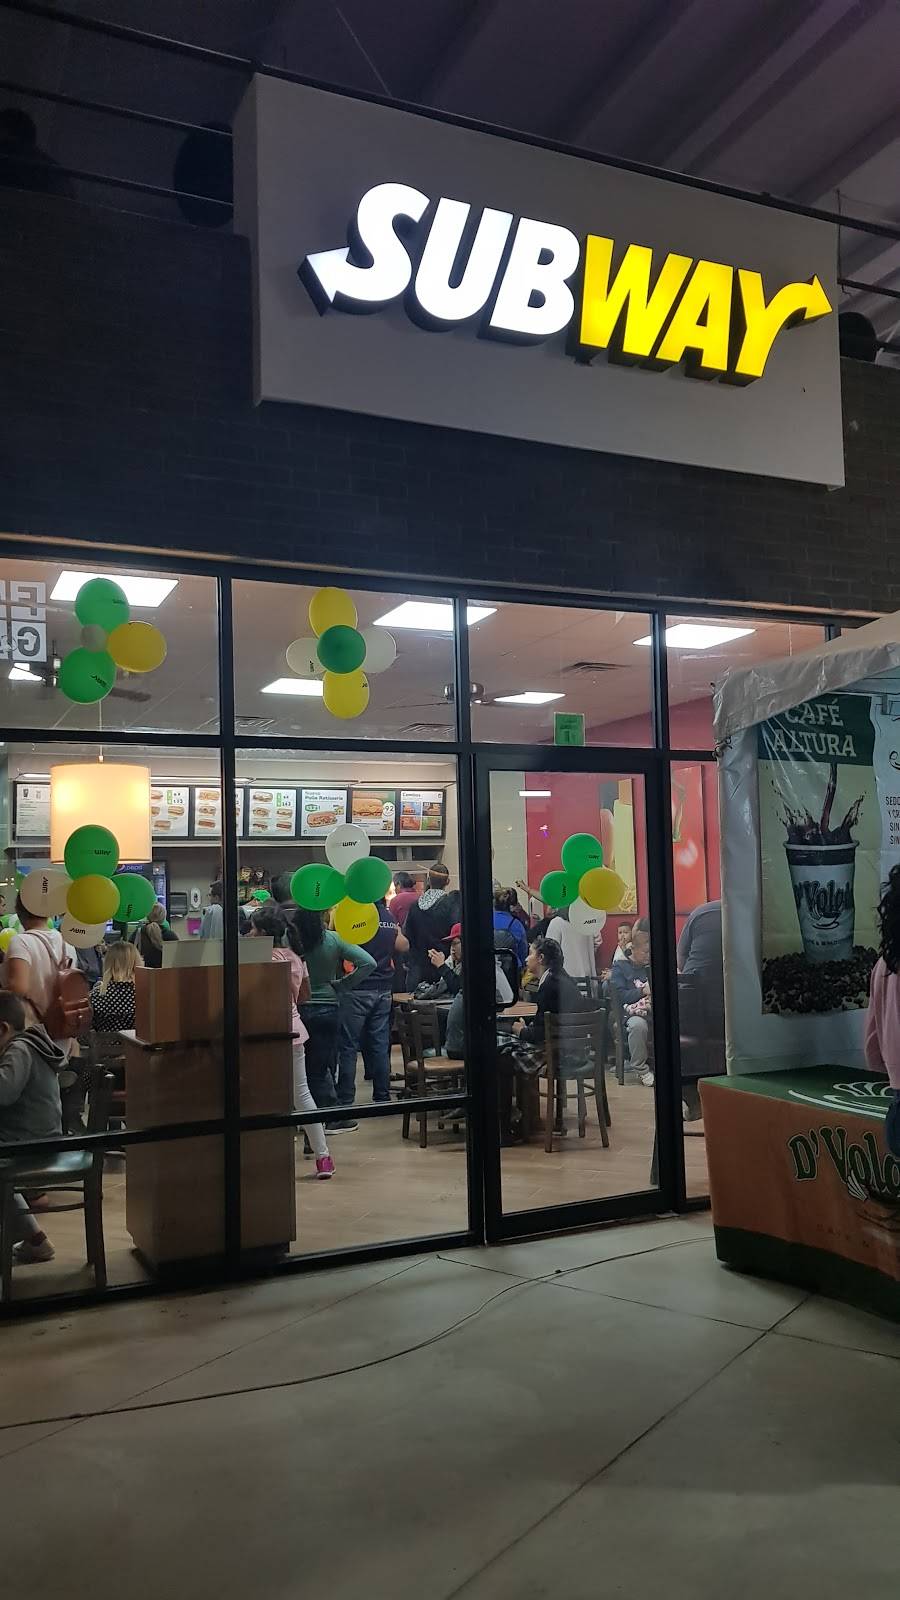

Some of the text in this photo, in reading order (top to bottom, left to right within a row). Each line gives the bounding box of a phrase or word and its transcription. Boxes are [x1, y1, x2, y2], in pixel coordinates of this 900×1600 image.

[302, 182, 833, 380] SUBWAY
[784, 698, 844, 727] CAFÉ
[772, 728, 857, 757] ALTURA
